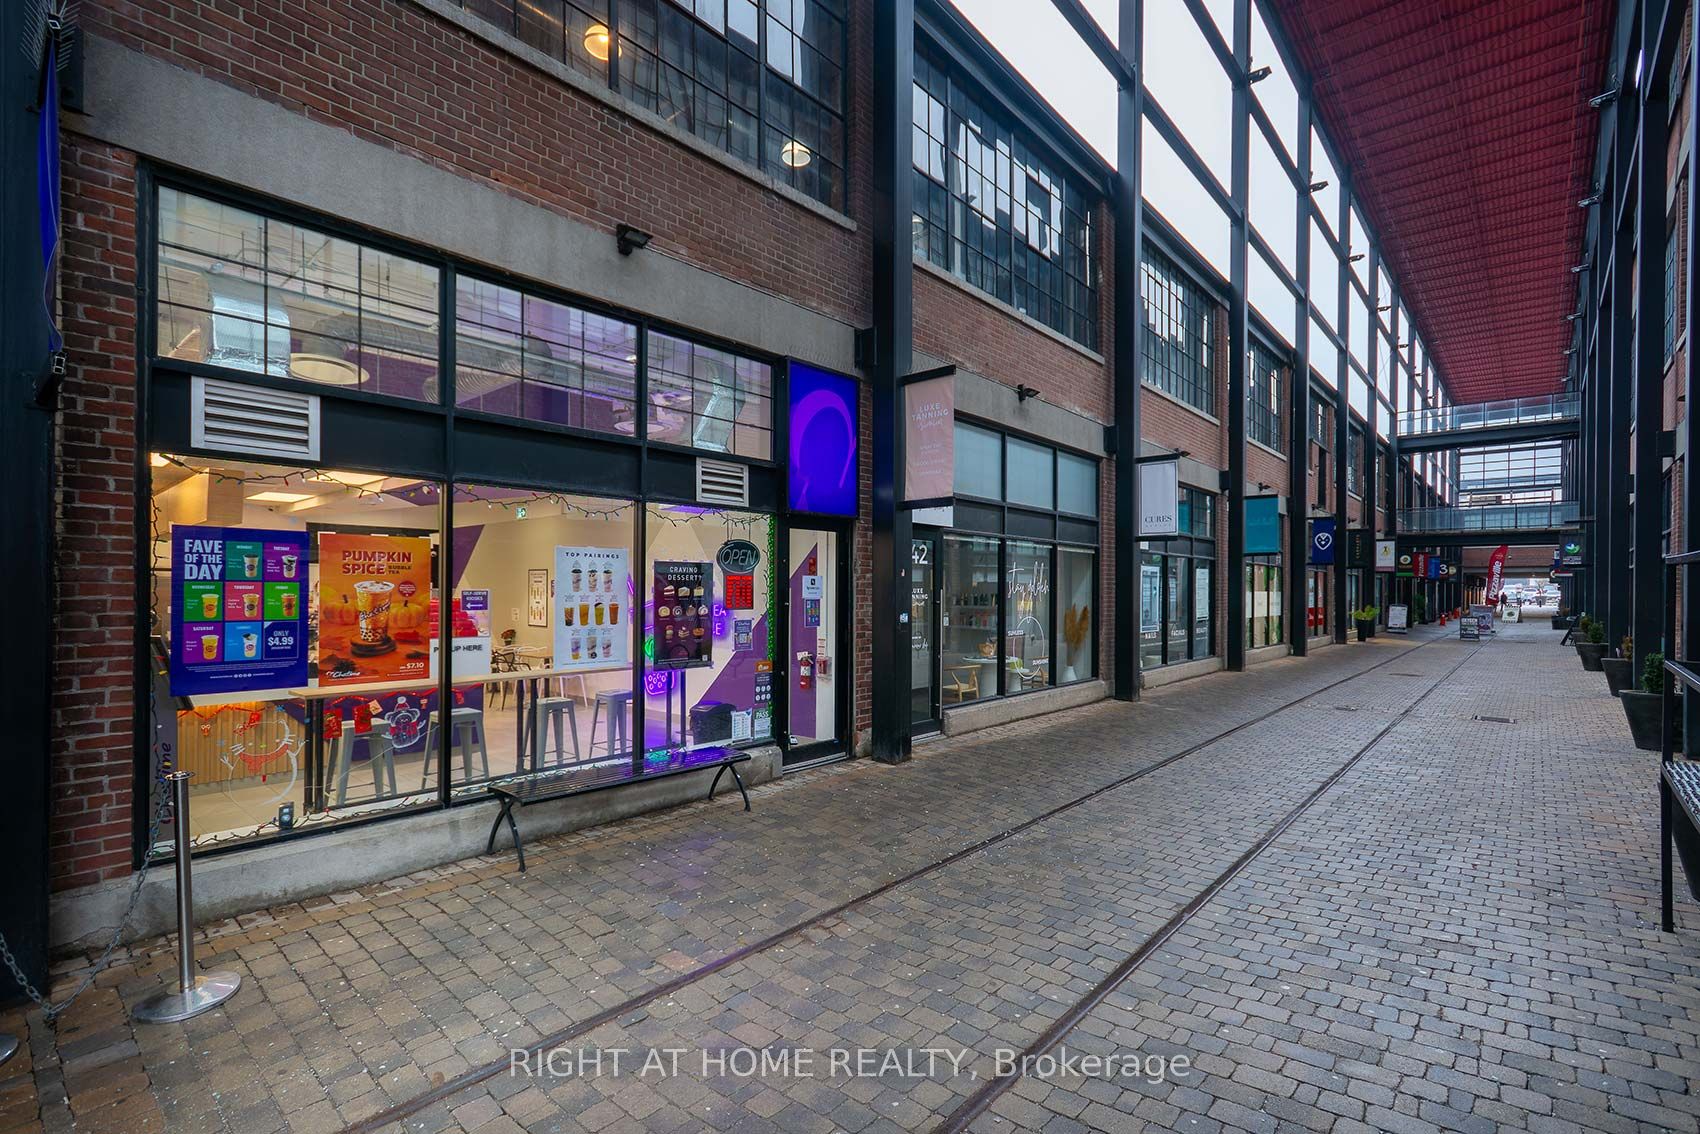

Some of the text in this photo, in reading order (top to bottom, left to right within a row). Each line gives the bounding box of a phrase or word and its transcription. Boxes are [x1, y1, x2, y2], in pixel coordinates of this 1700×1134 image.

[919, 402, 941, 412] LUXE
[912, 408, 949, 421] TANNING
[1144, 515, 1172, 523] CURES
[184, 538, 223, 553] FAVE
[184, 553, 223, 563] OF THE
[342, 550, 412, 563] PUMPKIN
[722, 548, 757, 565] OPEN
[184, 564, 223, 580] DAY
[342, 563, 386, 575] SPICE
[267, 636, 294, 647] $4.99
[463, 644, 483, 652] HERE
